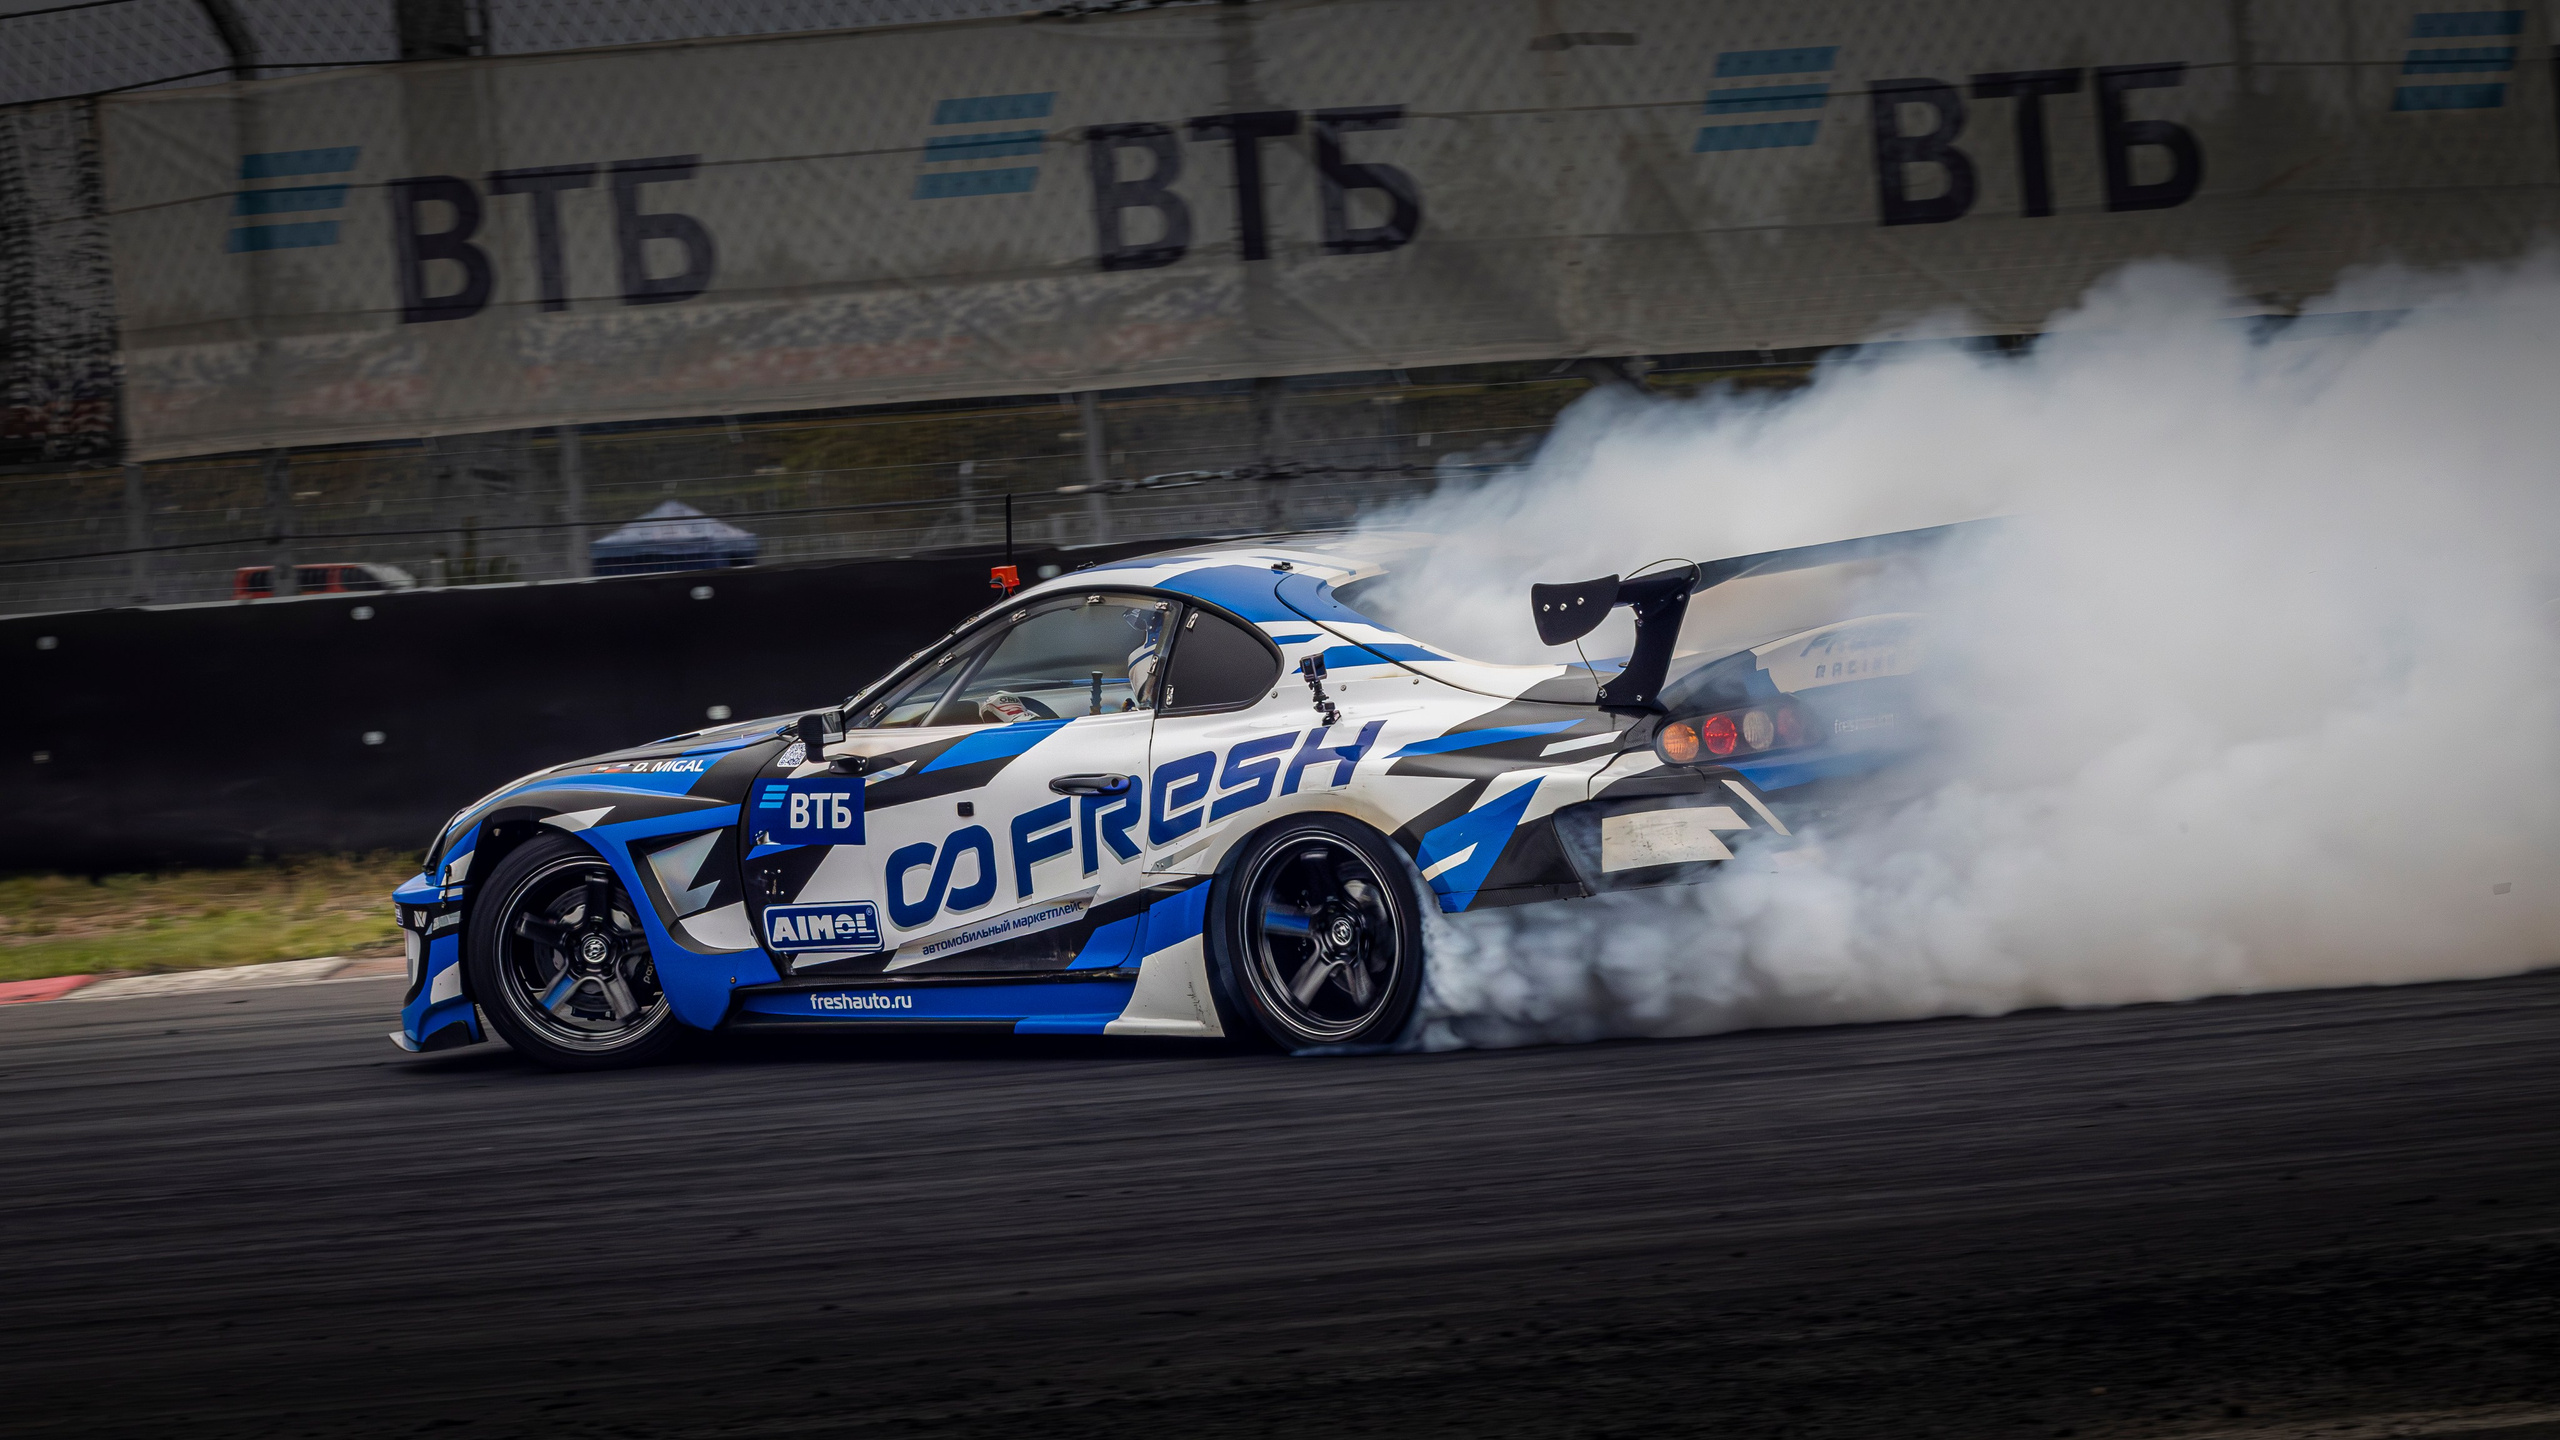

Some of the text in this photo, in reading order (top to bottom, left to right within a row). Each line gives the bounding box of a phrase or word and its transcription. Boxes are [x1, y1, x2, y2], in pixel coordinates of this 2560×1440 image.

[1868, 62, 2204, 227] ВТБ
[1085, 104, 1423, 272] ВТБ
[387, 154, 719, 325] ВТБ
[632, 759, 705, 773] D. MIGAL
[790, 792, 852, 830] ВТБ
[772, 912, 877, 942] AIMOL
[921, 899, 1085, 956] автомобильный маркетплейс
[810, 993, 913, 1010] freshauto.ru
